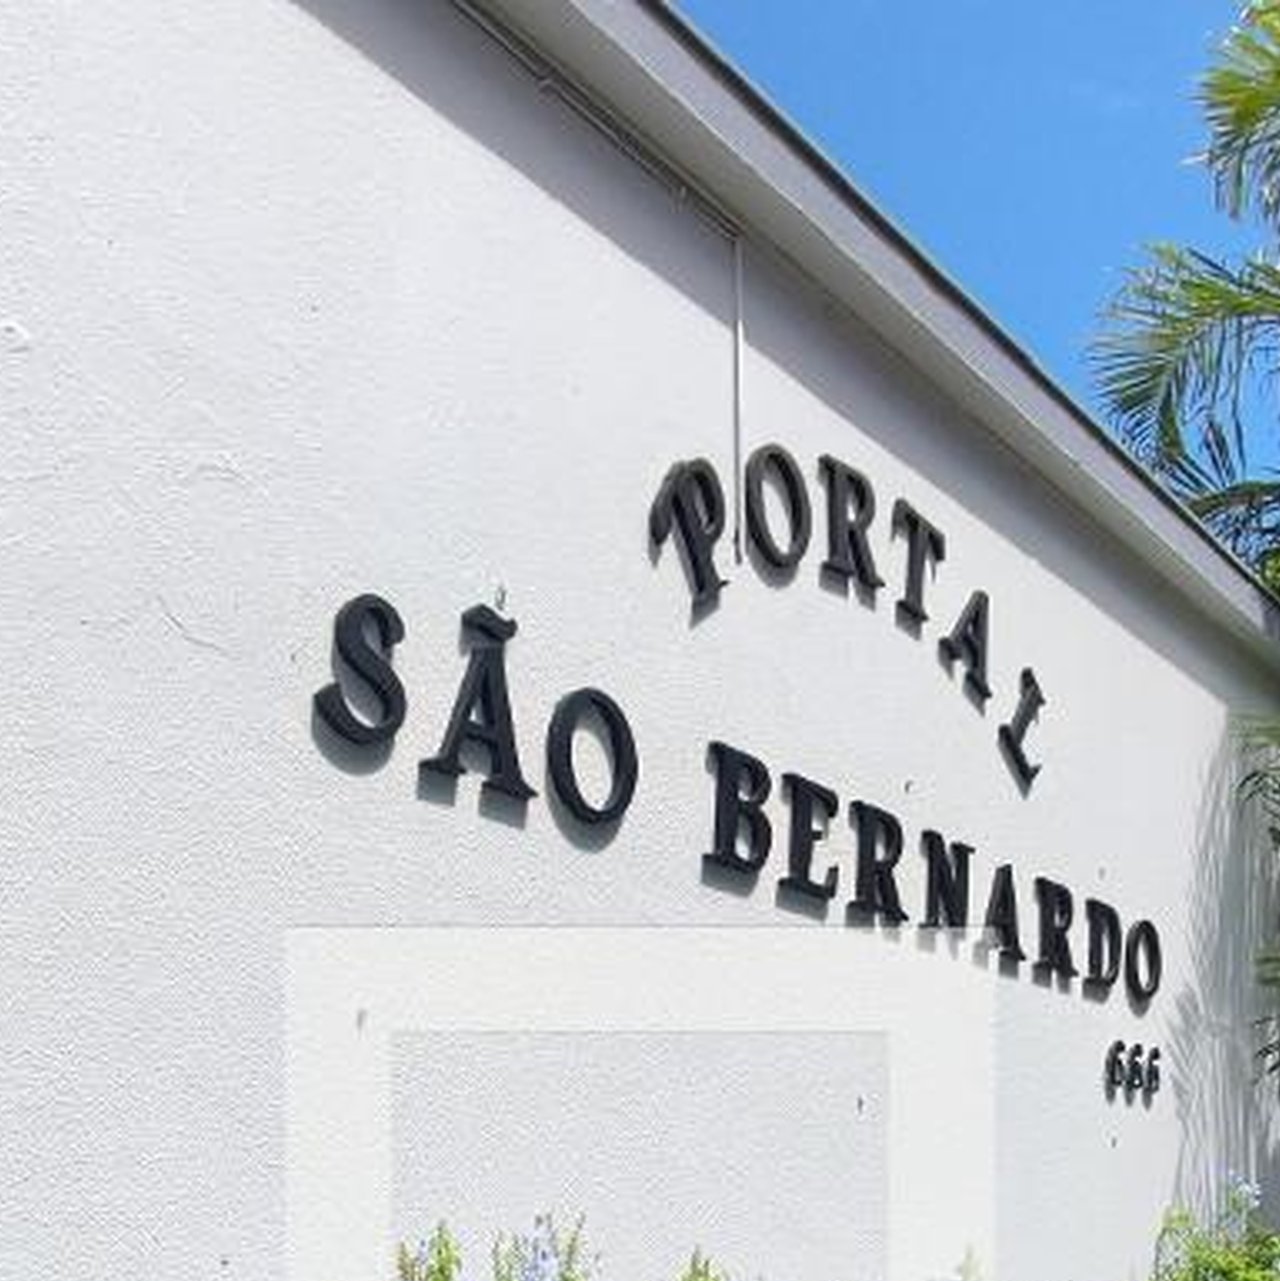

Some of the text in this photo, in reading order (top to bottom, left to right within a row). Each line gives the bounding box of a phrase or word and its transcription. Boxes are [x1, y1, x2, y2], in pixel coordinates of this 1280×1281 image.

[649, 444, 1046, 792] PORTAL
[313, 594, 1162, 1004] SÃO BERNARDO
[1105, 1040, 1160, 1094] 666
